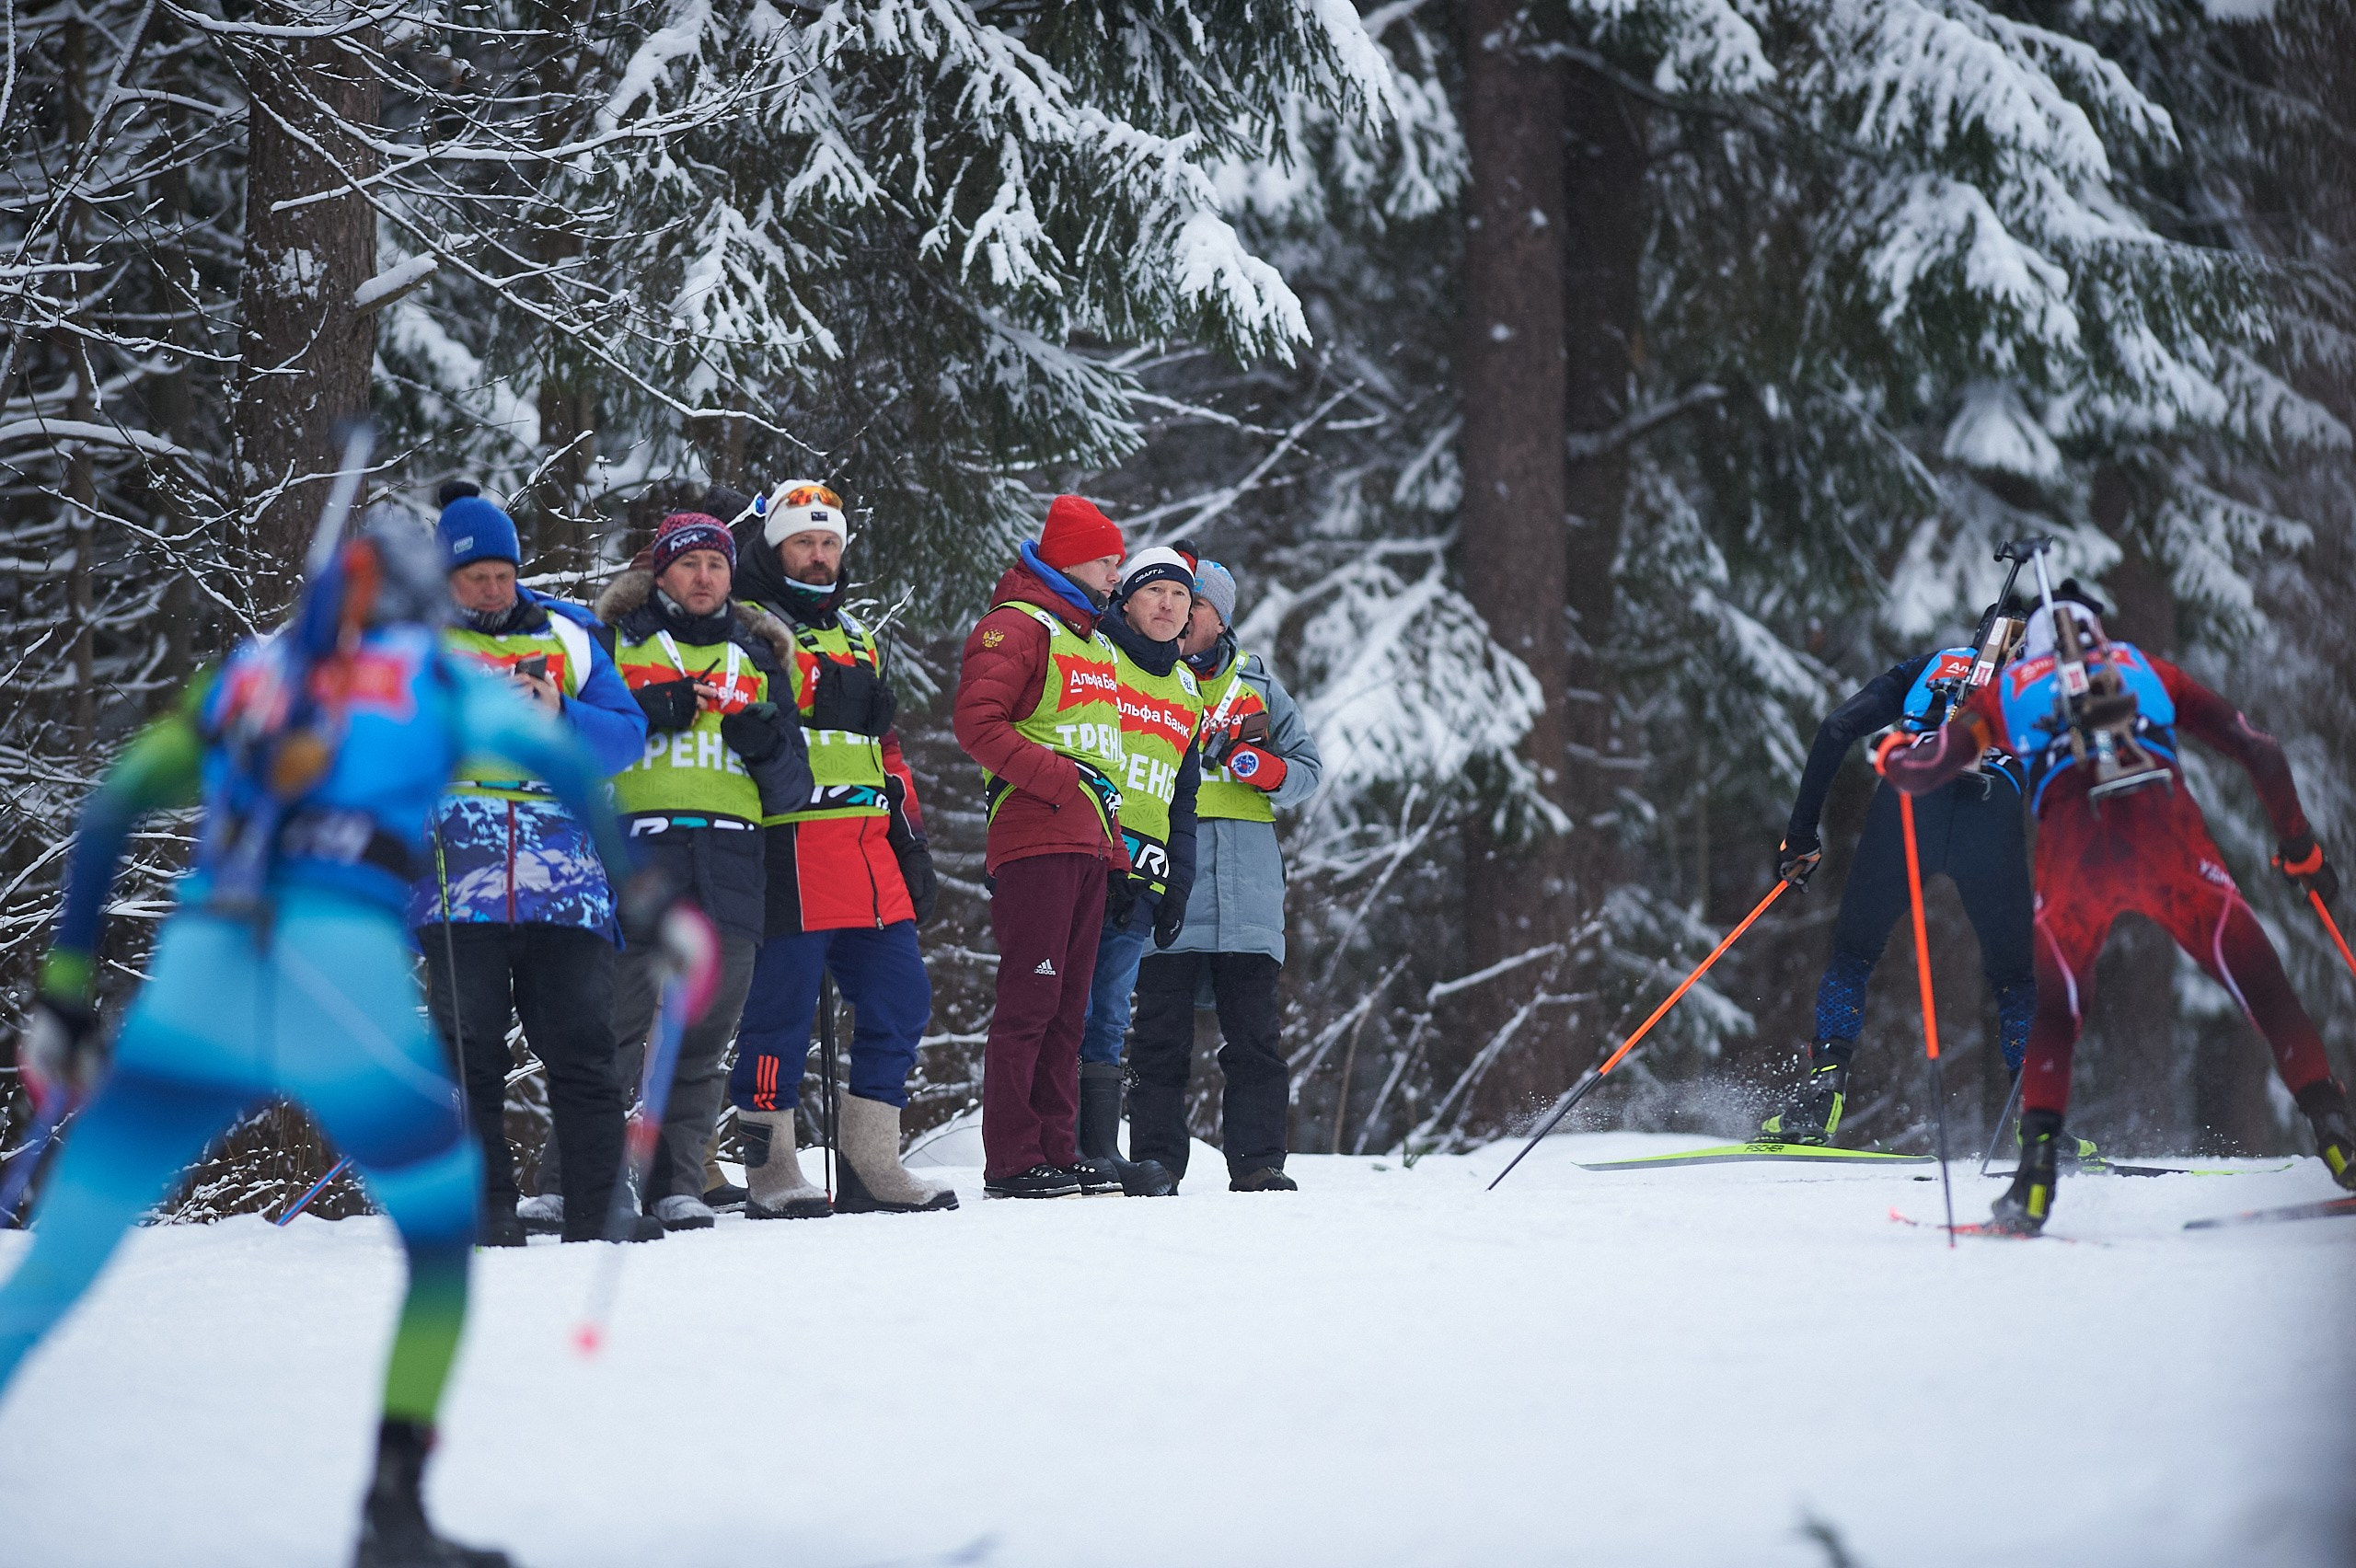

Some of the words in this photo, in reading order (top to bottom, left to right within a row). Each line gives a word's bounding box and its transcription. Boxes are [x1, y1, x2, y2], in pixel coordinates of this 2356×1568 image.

[1135, 569, 1159, 583] CRAFT
[1069, 669, 1103, 690] Альфа
[1163, 709, 1190, 739] Банк
[1744, 1144, 1784, 1153] FISCHER
